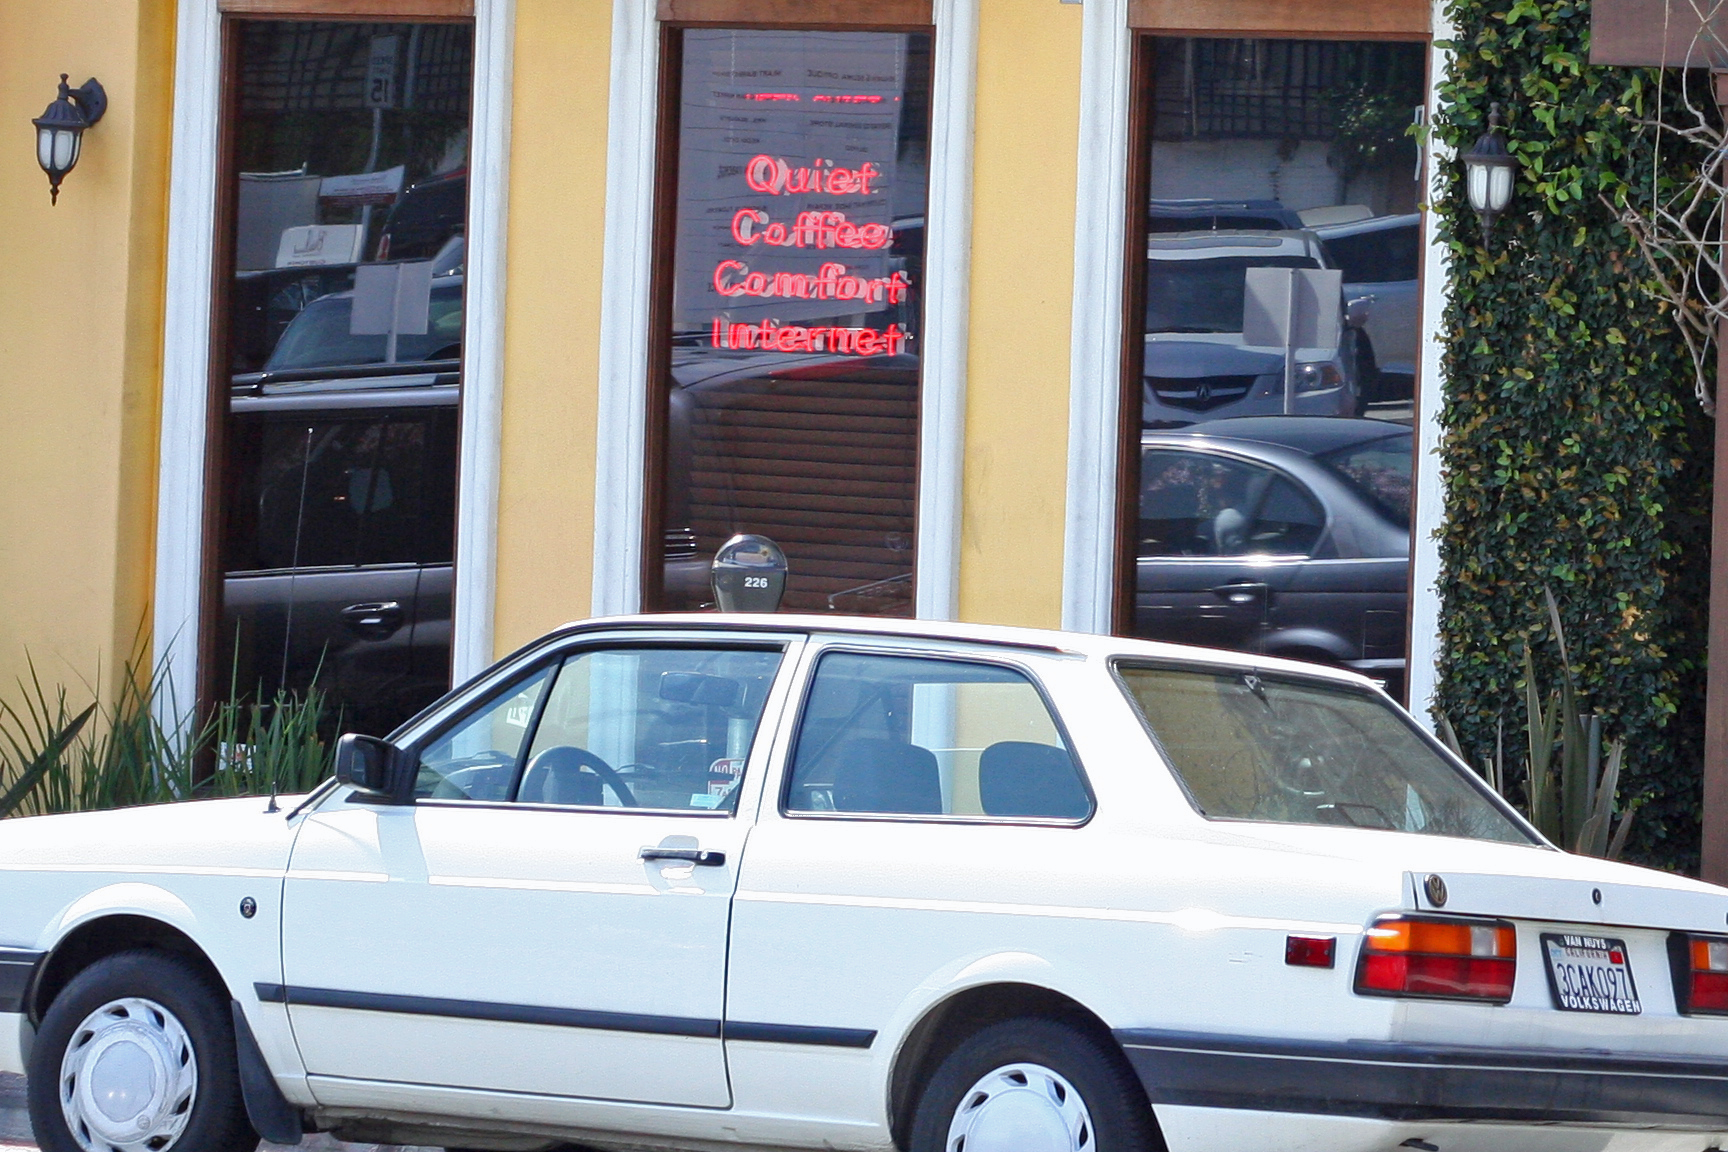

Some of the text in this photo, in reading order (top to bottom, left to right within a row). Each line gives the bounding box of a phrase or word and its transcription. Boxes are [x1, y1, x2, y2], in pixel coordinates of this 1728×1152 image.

[745, 154, 879, 196] Quiet
[731, 208, 888, 250] Coffee
[713, 260, 909, 305] Comfort
[711, 317, 905, 357] Internet
[744, 576, 768, 588] 226
[1563, 935, 1608, 950] VAN NUYS
[1556, 963, 1630, 999] 3CAK097
[1560, 994, 1641, 1013] VOLKSWAGEN
